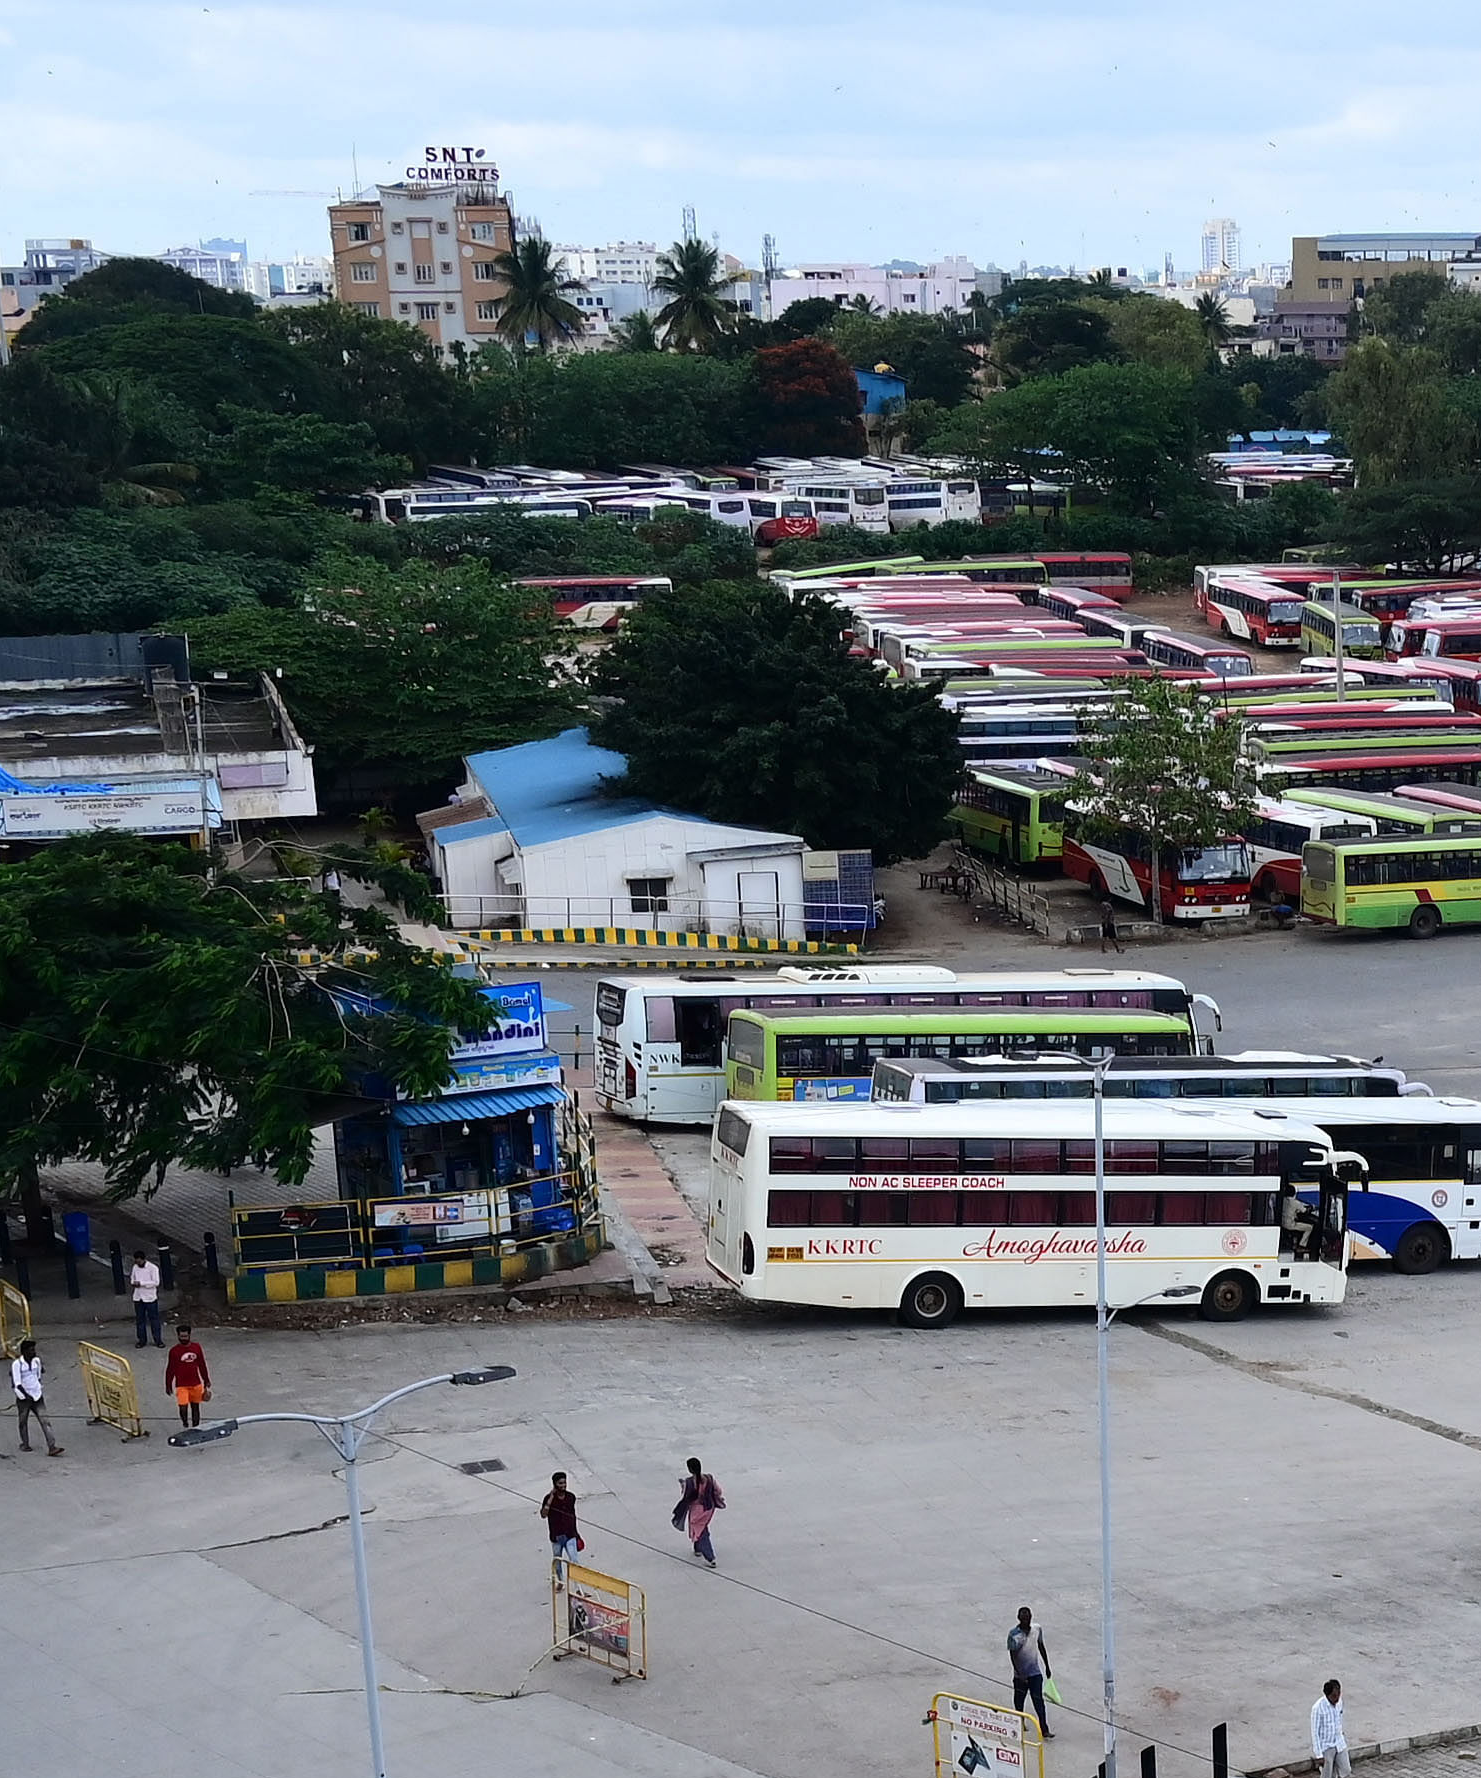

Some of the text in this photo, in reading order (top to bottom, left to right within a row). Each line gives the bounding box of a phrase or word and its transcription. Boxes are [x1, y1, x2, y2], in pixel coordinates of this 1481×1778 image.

[426, 146, 475, 162] SNT
[406, 166, 500, 181] COMFORTS
[164, 806, 195, 814] CARGO
[848, 1177, 1005, 1189] NON AC SLEEPER COACH
[807, 1238, 883, 1257] KKRTC
[962, 1228, 1147, 1264] Amoghavasha
[960, 1716, 1008, 1736] NO PARKING
[997, 1750, 1020, 1765] GM
